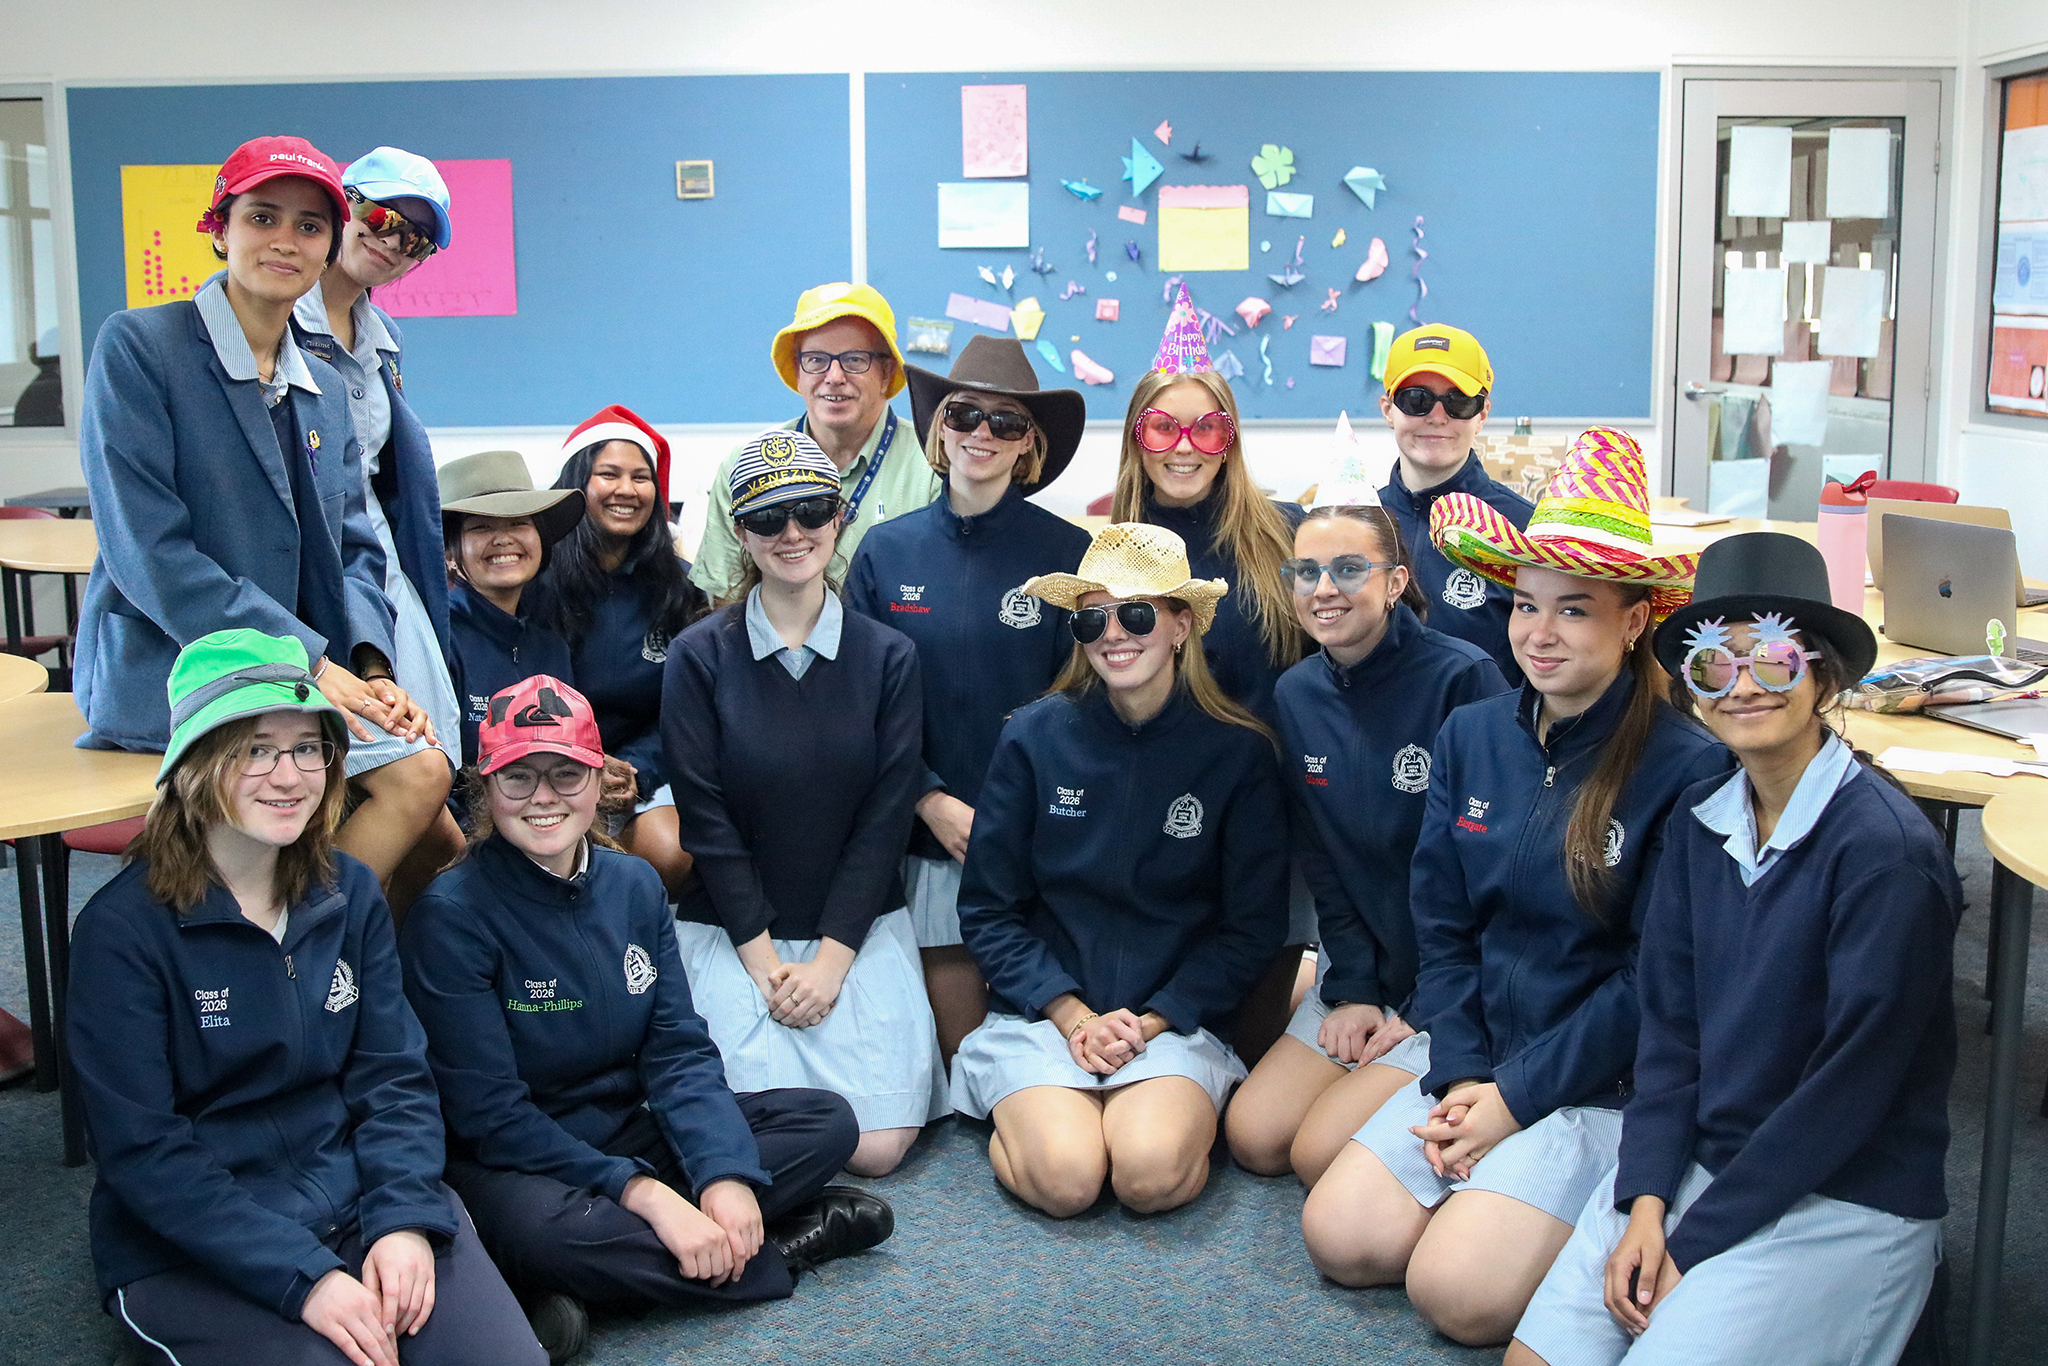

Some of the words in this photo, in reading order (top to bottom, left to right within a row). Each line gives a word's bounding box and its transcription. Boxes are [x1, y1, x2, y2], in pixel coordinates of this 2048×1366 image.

[270, 153, 296, 162] paul
[297, 154, 327, 172] frank
[1174, 332, 1201, 342] Happy
[747, 469, 817, 492] VENEZIA
[900, 584, 916, 593] Class
[917, 585, 926, 593] of
[902, 592, 920, 601] 2026
[890, 602, 931, 613] Bradshaw
[473, 702, 488, 711] 2026
[1319, 756, 1328, 764] of
[1307, 763, 1324, 773] 2026
[1056, 786, 1075, 796] Class
[1076, 789, 1085, 797] of
[1059, 795, 1081, 806] 2026
[1482, 801, 1490, 810] of
[1049, 804, 1087, 817] Butcher
[1467, 806, 1485, 819] 2026
[524, 979, 547, 989] Class
[548, 978, 557, 988] of
[194, 989, 219, 1001] Class
[220, 987, 230, 998] of
[530, 988, 555, 999] 2026
[200, 999, 228, 1013] 2026
[200, 1014, 231, 1028] Elita
